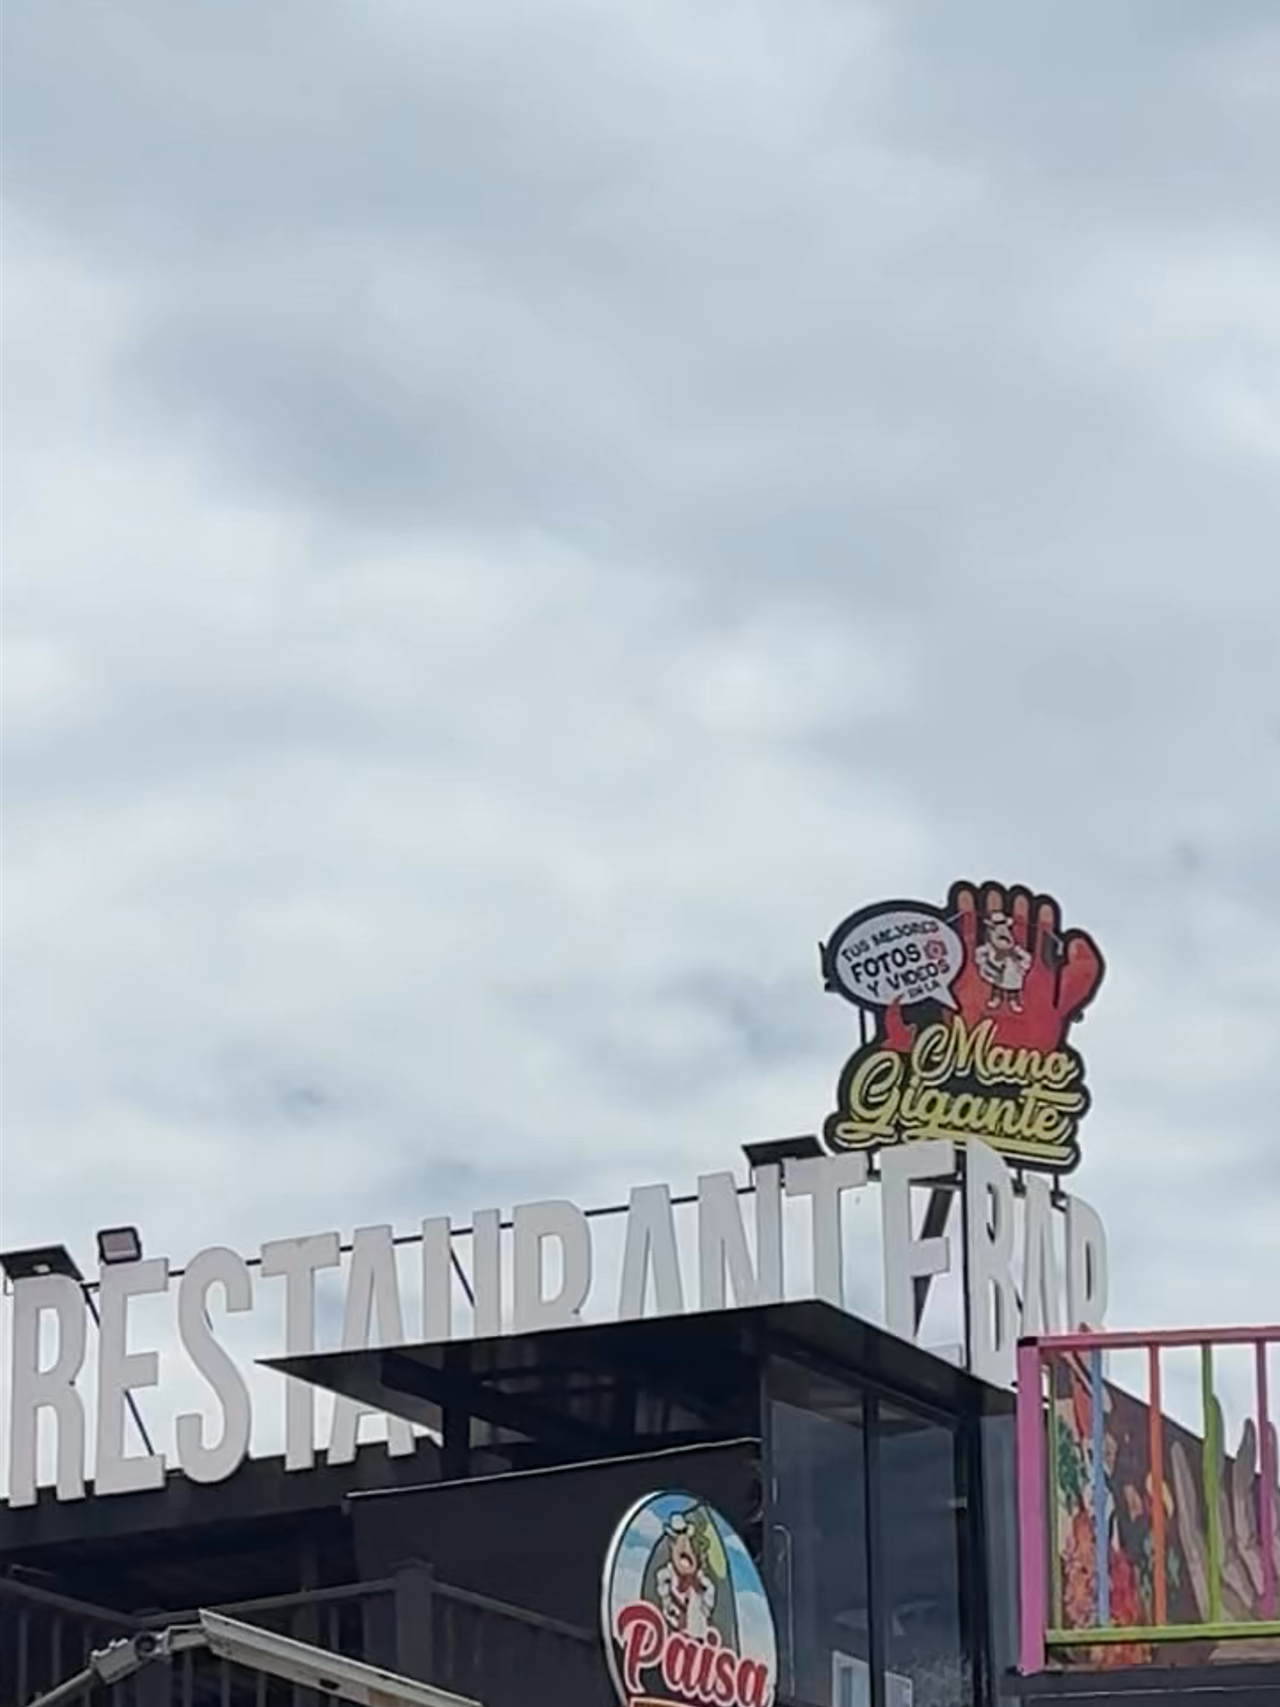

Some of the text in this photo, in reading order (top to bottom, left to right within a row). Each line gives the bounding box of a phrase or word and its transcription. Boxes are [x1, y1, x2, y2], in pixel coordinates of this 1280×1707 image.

[842, 920, 940, 963] TUS MEJORES
[850, 943, 922, 984] FOTOS
[865, 958, 951, 999] Y VIDEOS
[911, 1014, 1080, 1089] Mano
[833, 1049, 1084, 1153] Gigante
